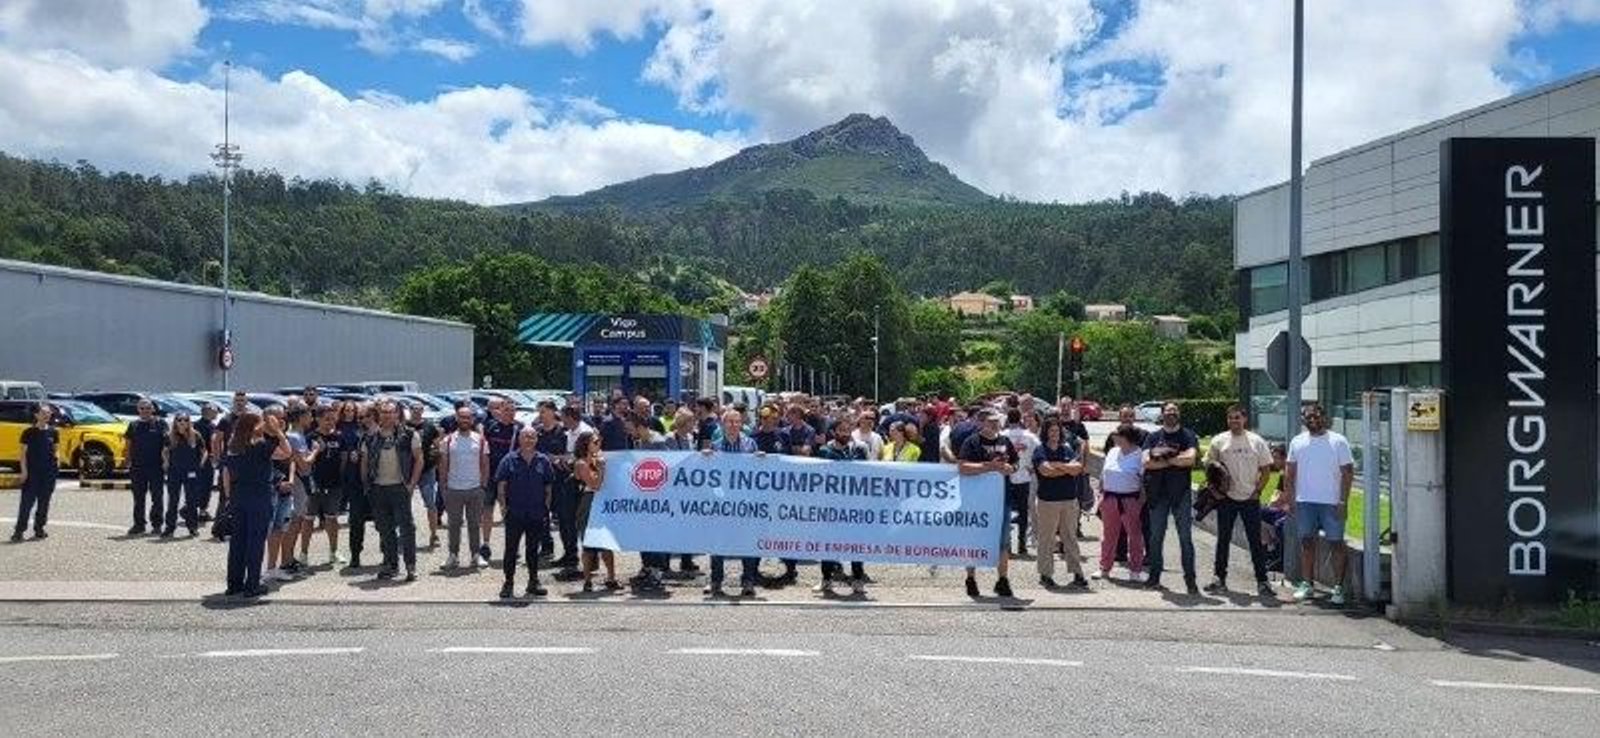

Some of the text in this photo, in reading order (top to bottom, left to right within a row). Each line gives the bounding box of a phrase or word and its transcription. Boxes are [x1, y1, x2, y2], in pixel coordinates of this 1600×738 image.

[610, 317, 637, 328] Vigo
[600, 328, 646, 340] Campus
[1506, 163, 1546, 576] BORGWARNER
[636, 472, 663, 482] STOP
[673, 467, 956, 499] AOS INCUMPRIMENTOS:
[600, 499, 990, 528] XORNADA, VACACIÓNS, CALENDARIO E CATEGORIAS
[805, 541, 820, 553] DE
[824, 543, 881, 555] EMPRESA
[885, 544, 900, 556] DE
[904, 545, 989, 560] BORGWARNER
